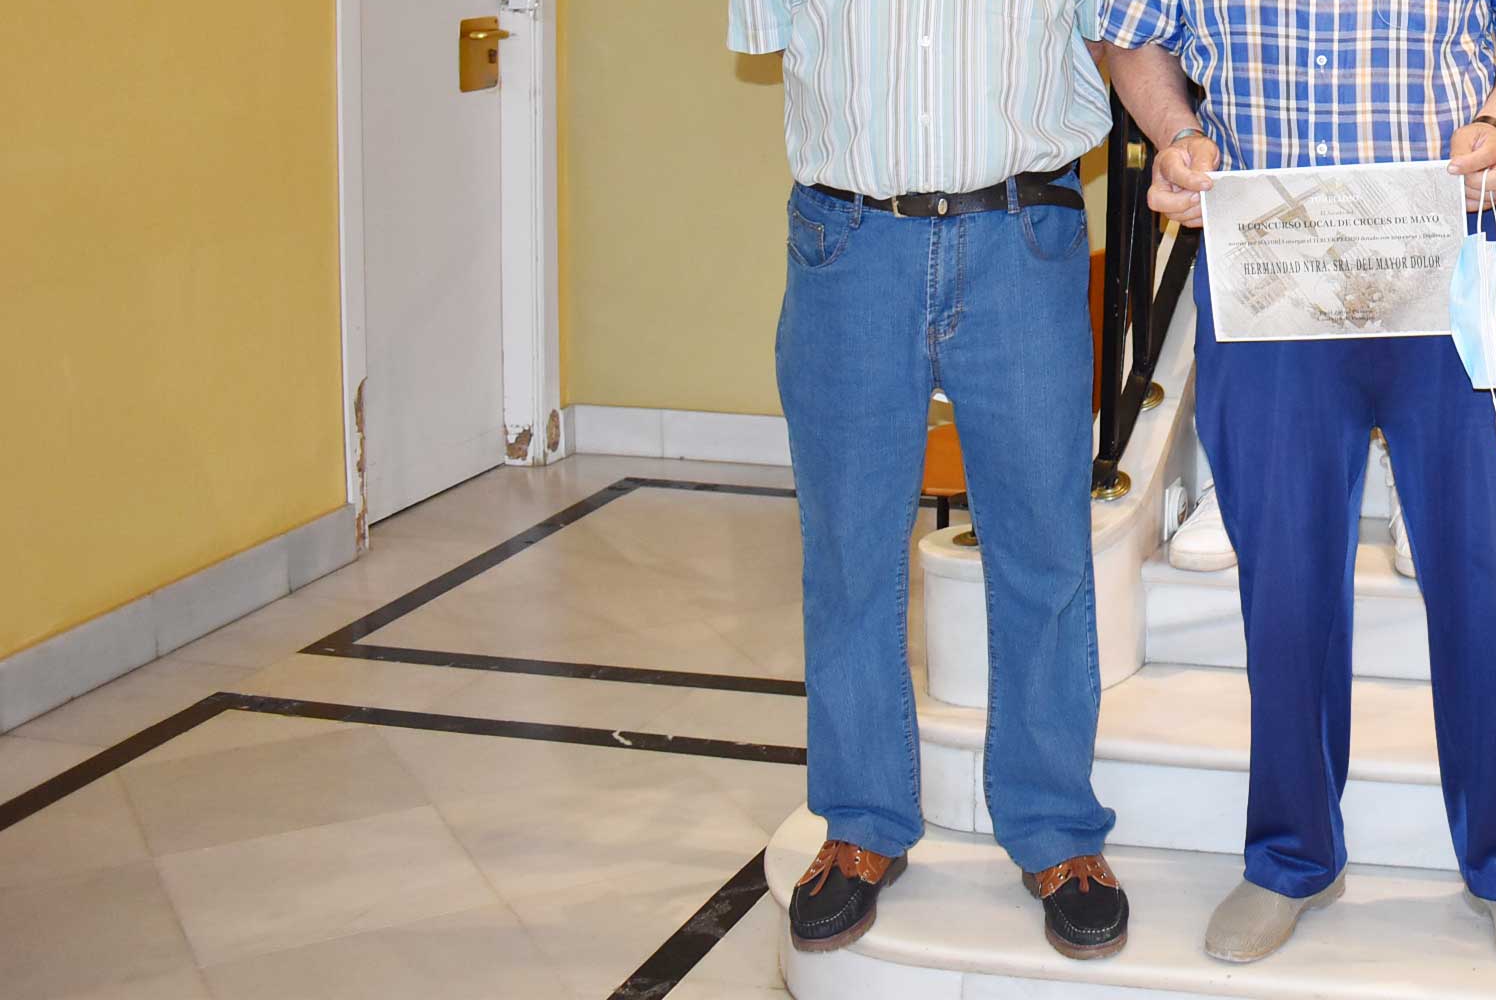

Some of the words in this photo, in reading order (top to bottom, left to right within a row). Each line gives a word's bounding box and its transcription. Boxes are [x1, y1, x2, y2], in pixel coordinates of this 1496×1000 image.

[1246, 221, 1301, 231] CONCURSO
[1304, 220, 1336, 229] LOCAL
[1338, 219, 1352, 228] DE
[1353, 217, 1392, 226] CRUCES
[1394, 216, 1408, 225] DE
[1410, 214, 1440, 224] MAYO
[1244, 260, 1300, 275] HERMANDAD
[1356, 258, 1374, 271] DEL
[1376, 257, 1408, 270] MAYOR
[1410, 256, 1441, 269] DOLOR
